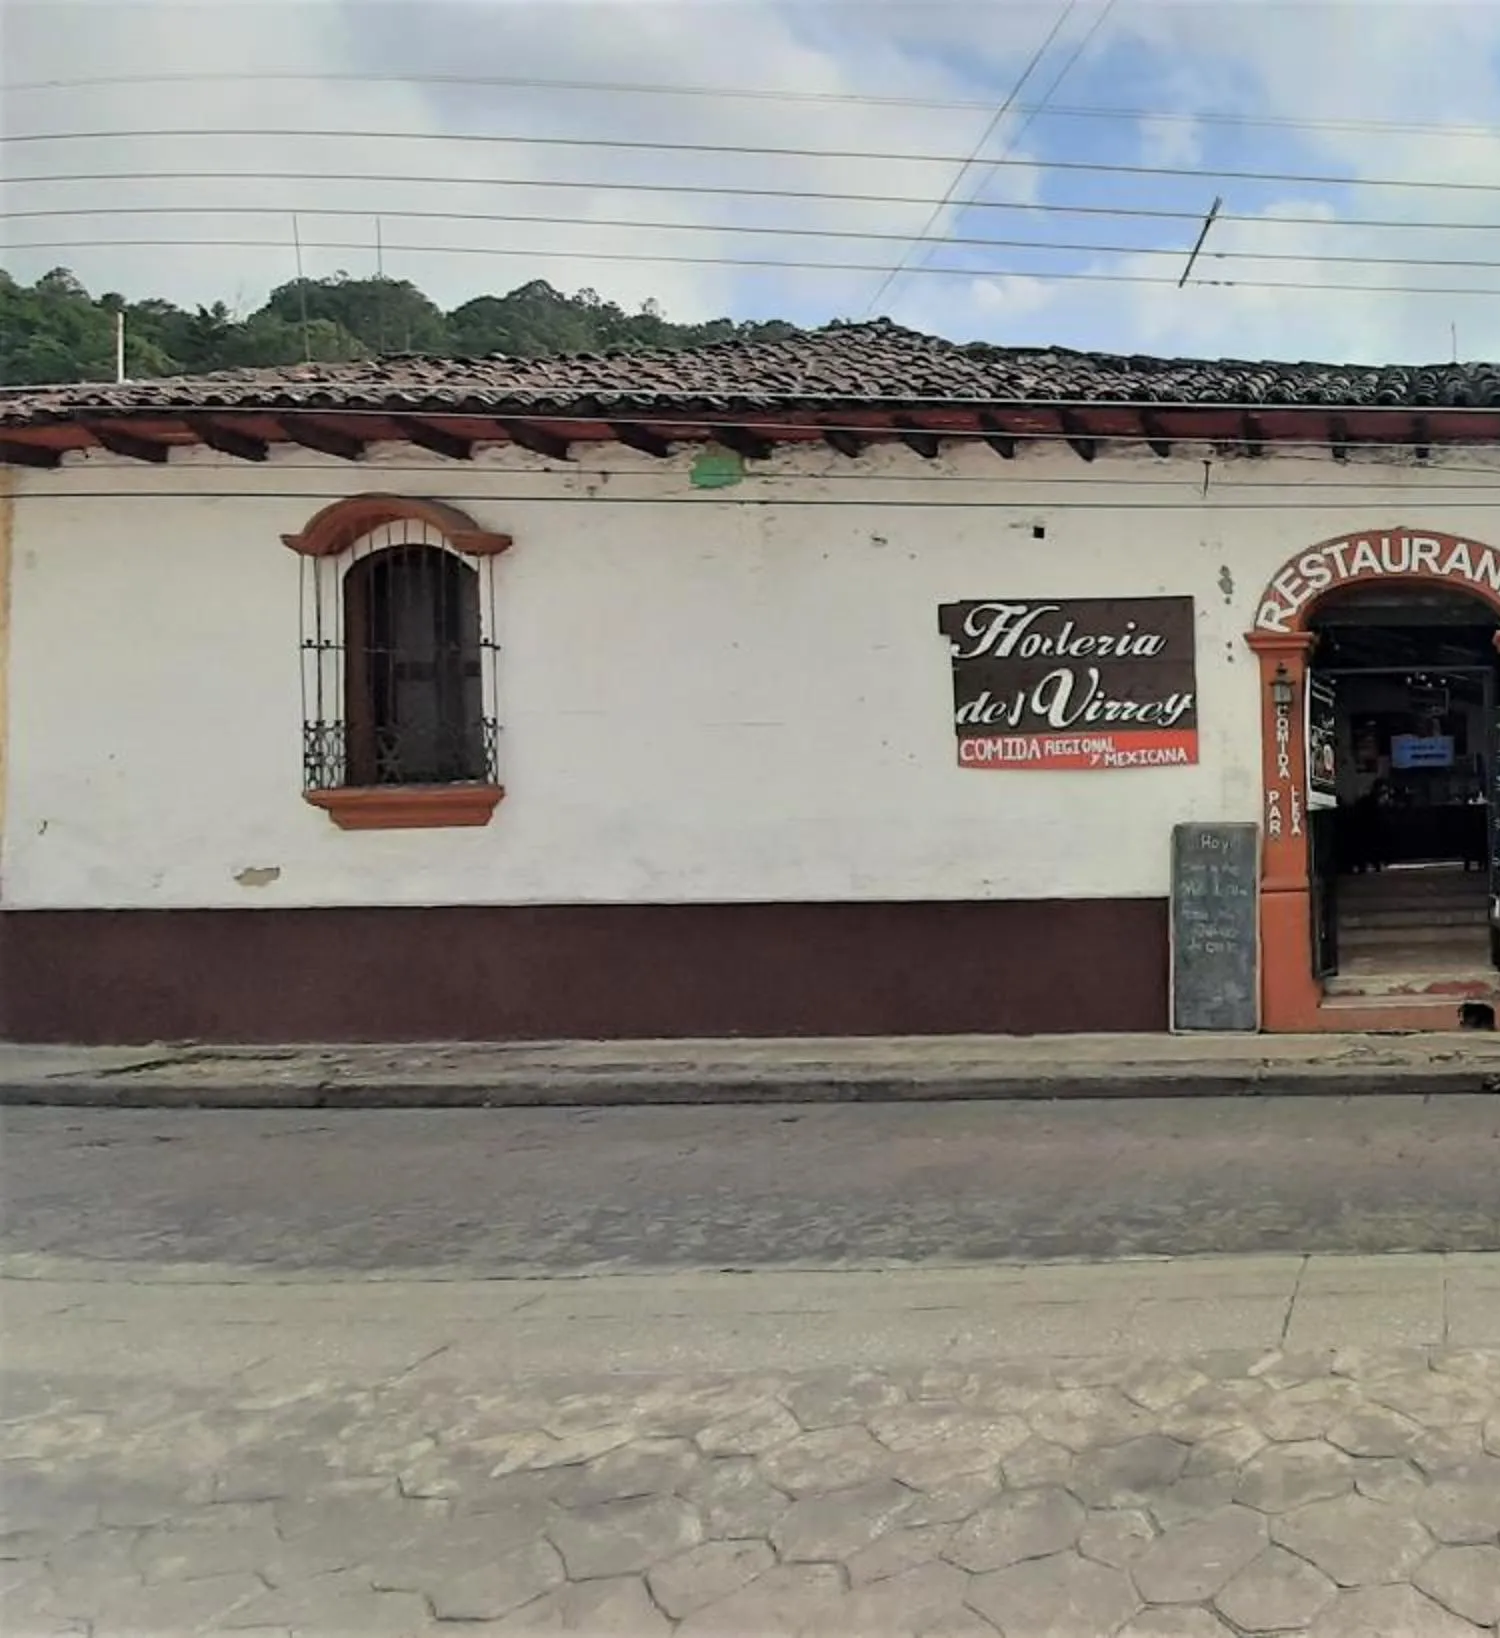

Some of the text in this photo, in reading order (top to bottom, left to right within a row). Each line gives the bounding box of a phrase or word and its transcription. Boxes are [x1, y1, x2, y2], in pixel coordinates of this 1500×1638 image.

[956, 667, 1194, 728] del Virrey
[959, 737, 1116, 761] COMIDA REGIONAL
[1104, 747, 1188, 766] MEXICANA
